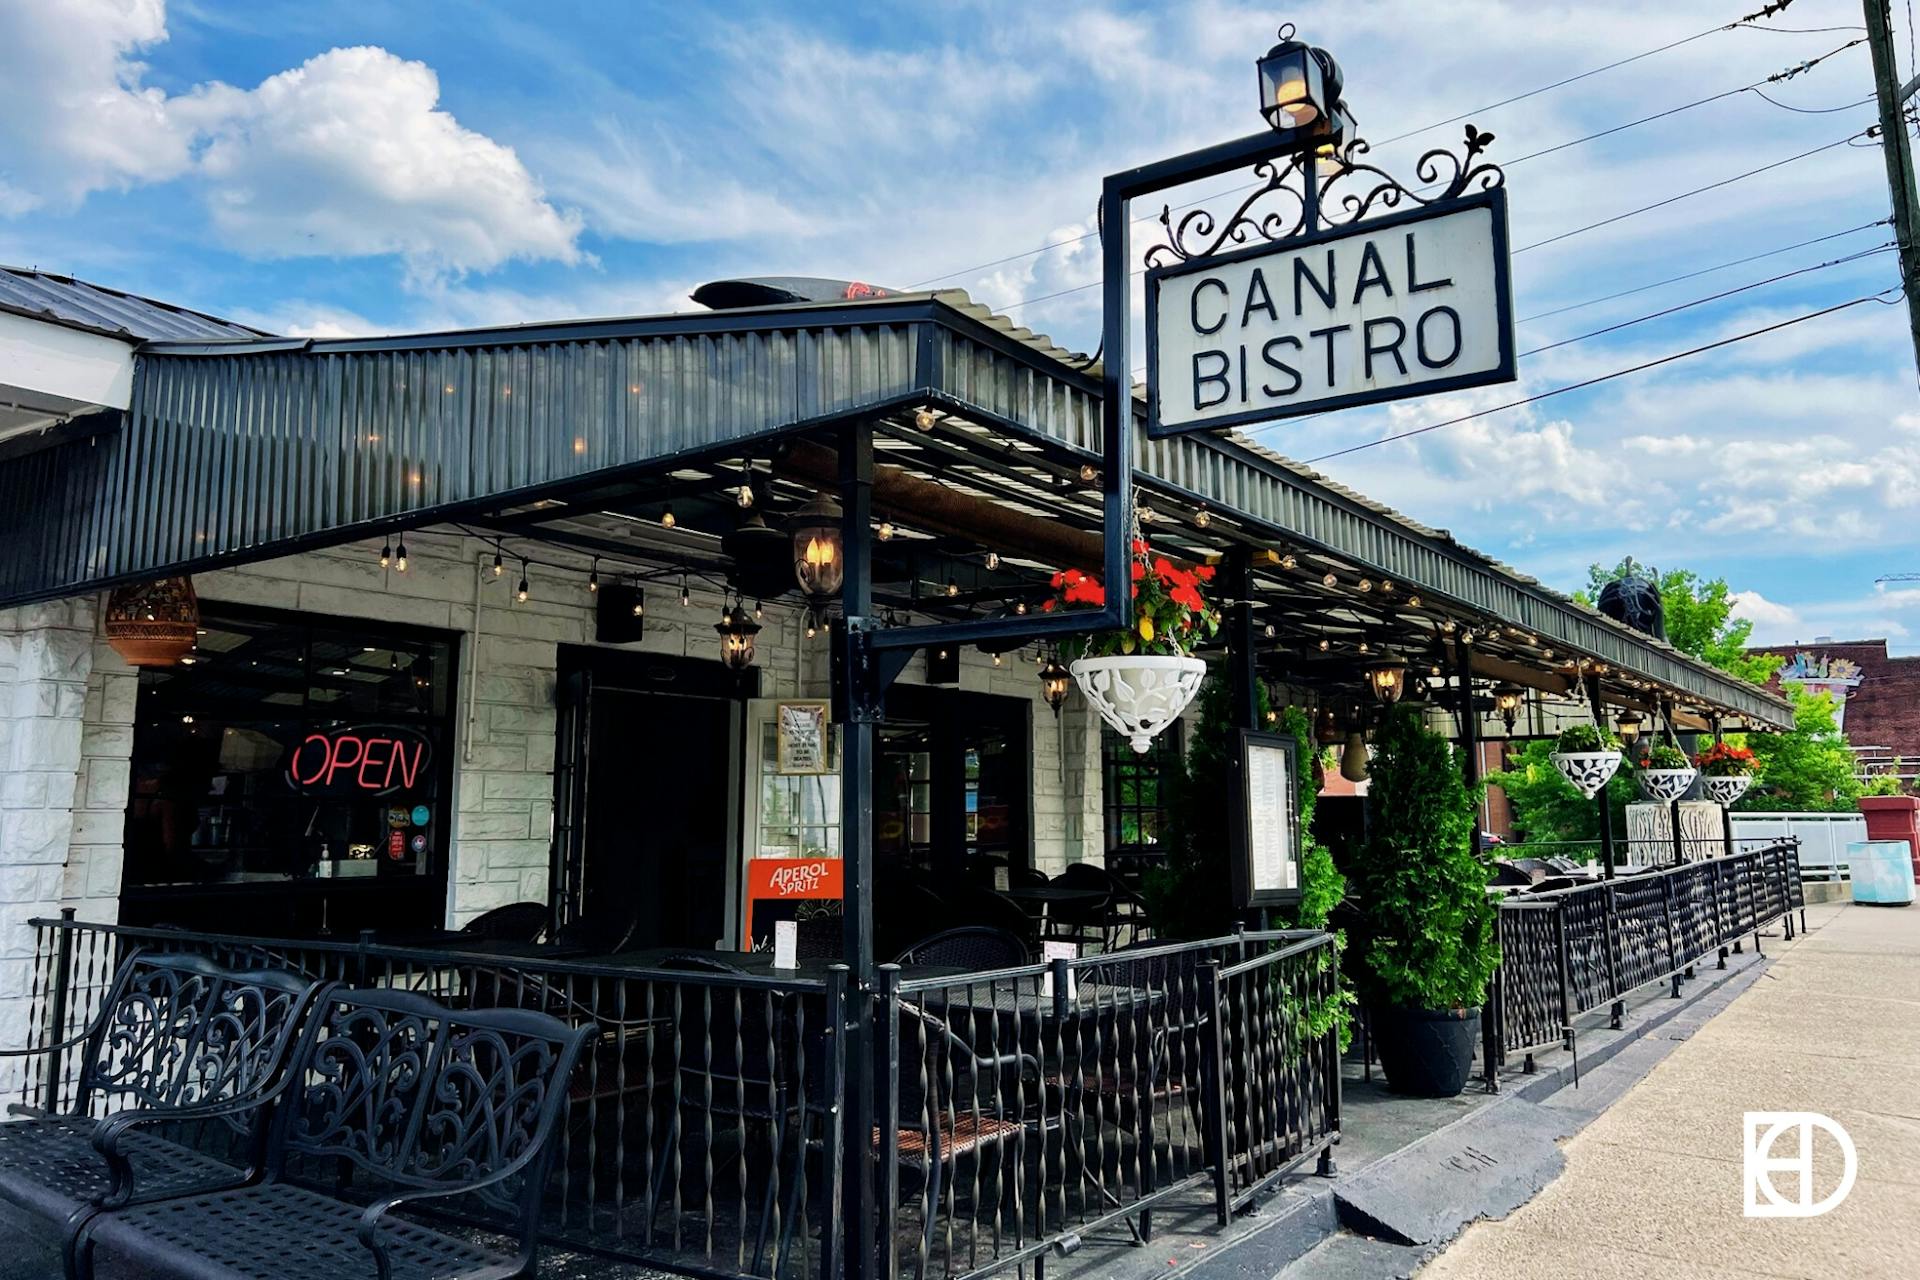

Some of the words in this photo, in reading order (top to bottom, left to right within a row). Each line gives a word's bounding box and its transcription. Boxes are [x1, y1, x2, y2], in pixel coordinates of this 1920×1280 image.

[1191, 232, 1454, 335] CANAL
[1193, 305, 1463, 411] BISTRO
[292, 735, 423, 788] OPEN
[769, 862, 828, 888] APEROL
[779, 878, 819, 896] SPRITZ
